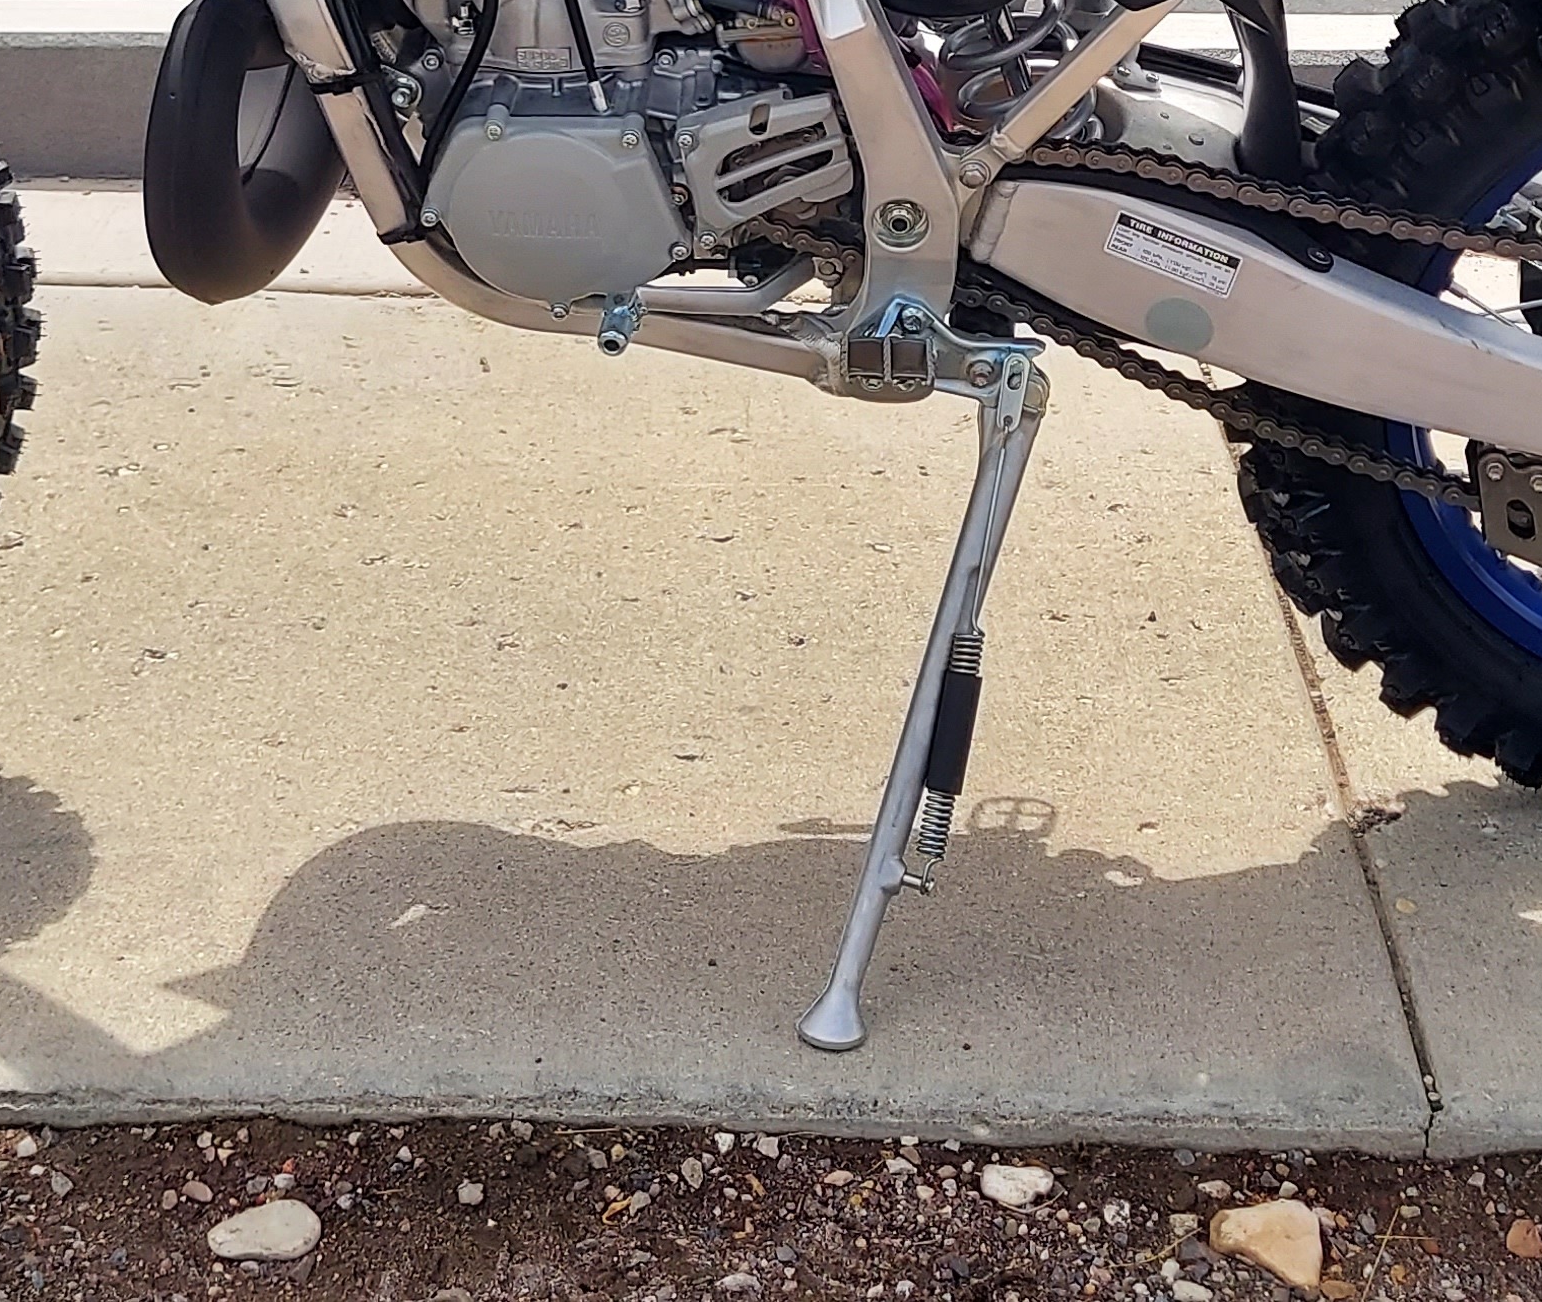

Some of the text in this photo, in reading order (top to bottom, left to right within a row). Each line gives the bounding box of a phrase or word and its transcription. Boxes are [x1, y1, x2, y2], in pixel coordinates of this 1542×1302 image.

[487, 209, 601, 239] YAMAHA
[1128, 218, 1154, 235] TIRE
[1157, 229, 1229, 265] INFORMATION
